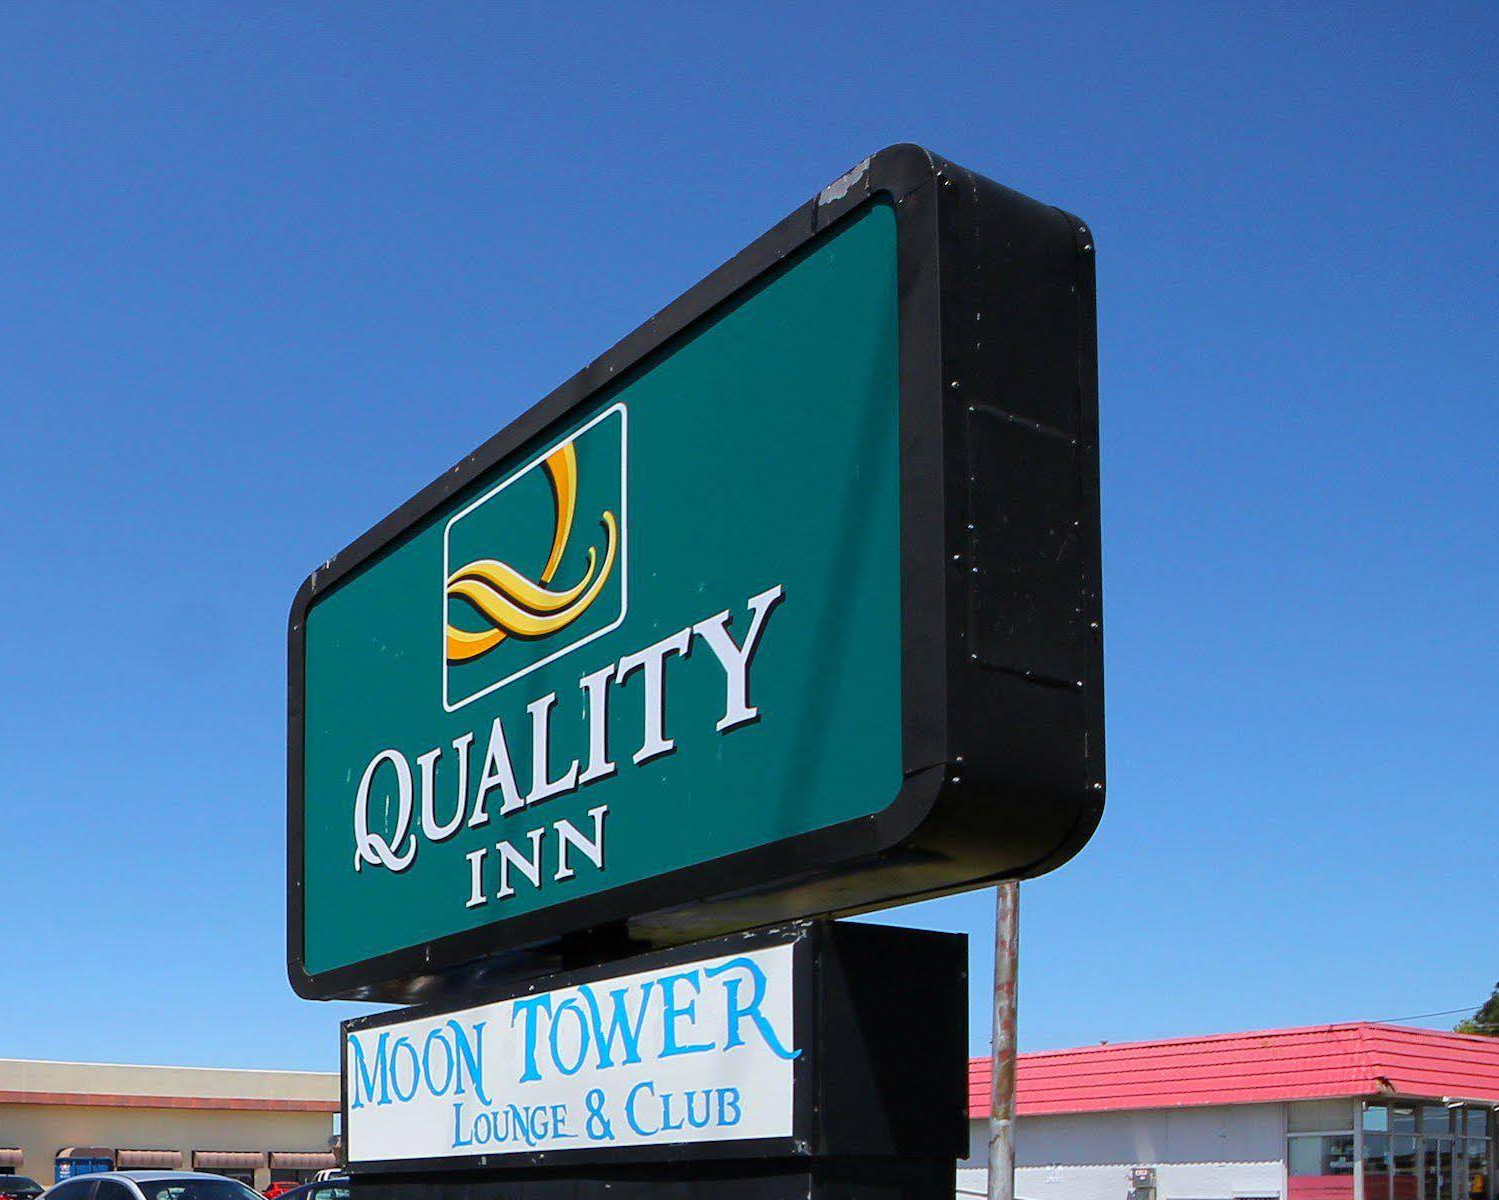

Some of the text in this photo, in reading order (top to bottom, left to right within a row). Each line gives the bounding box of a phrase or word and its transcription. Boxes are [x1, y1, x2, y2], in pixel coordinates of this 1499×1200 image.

[354, 584, 784, 873] QUALITY
[465, 805, 609, 909] INN
[347, 957, 802, 1110] MOON TOWER
[452, 1081, 742, 1148] LOUNGE & CLUB
